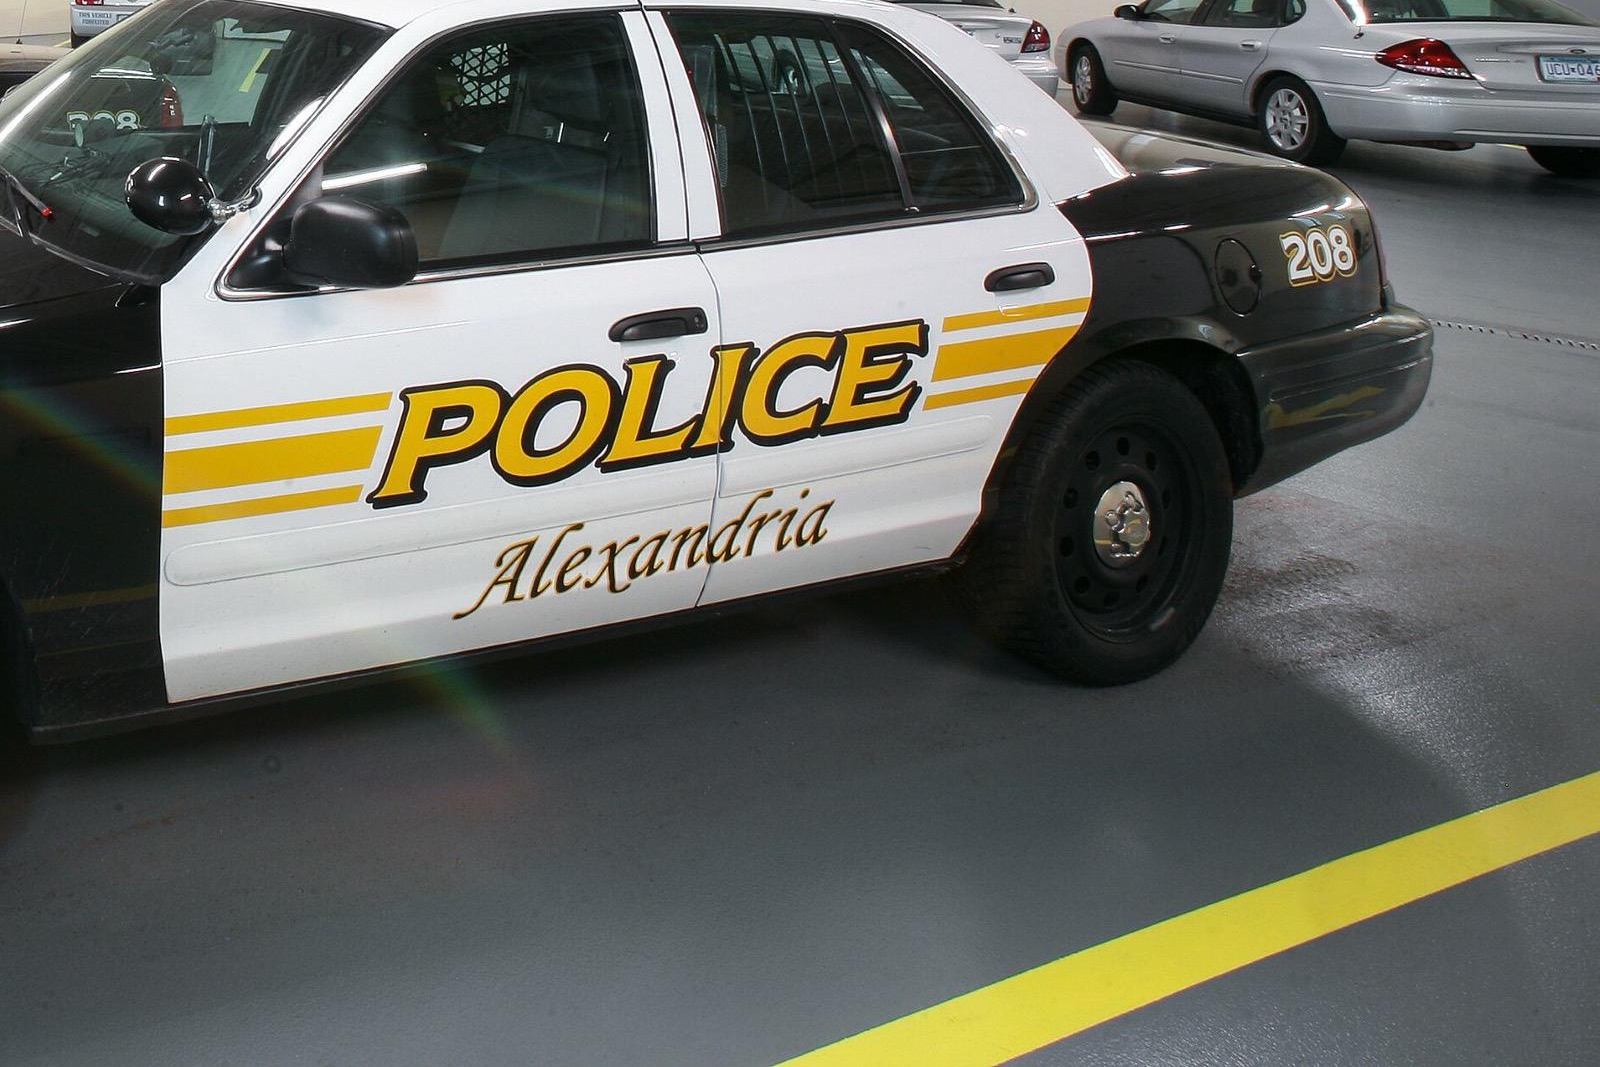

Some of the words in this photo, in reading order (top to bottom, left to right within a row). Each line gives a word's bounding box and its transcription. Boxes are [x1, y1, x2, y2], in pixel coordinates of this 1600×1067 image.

[1279, 224, 1358, 287] 208
[366, 318, 929, 508] POLICE
[452, 487, 836, 621] Alexandria
